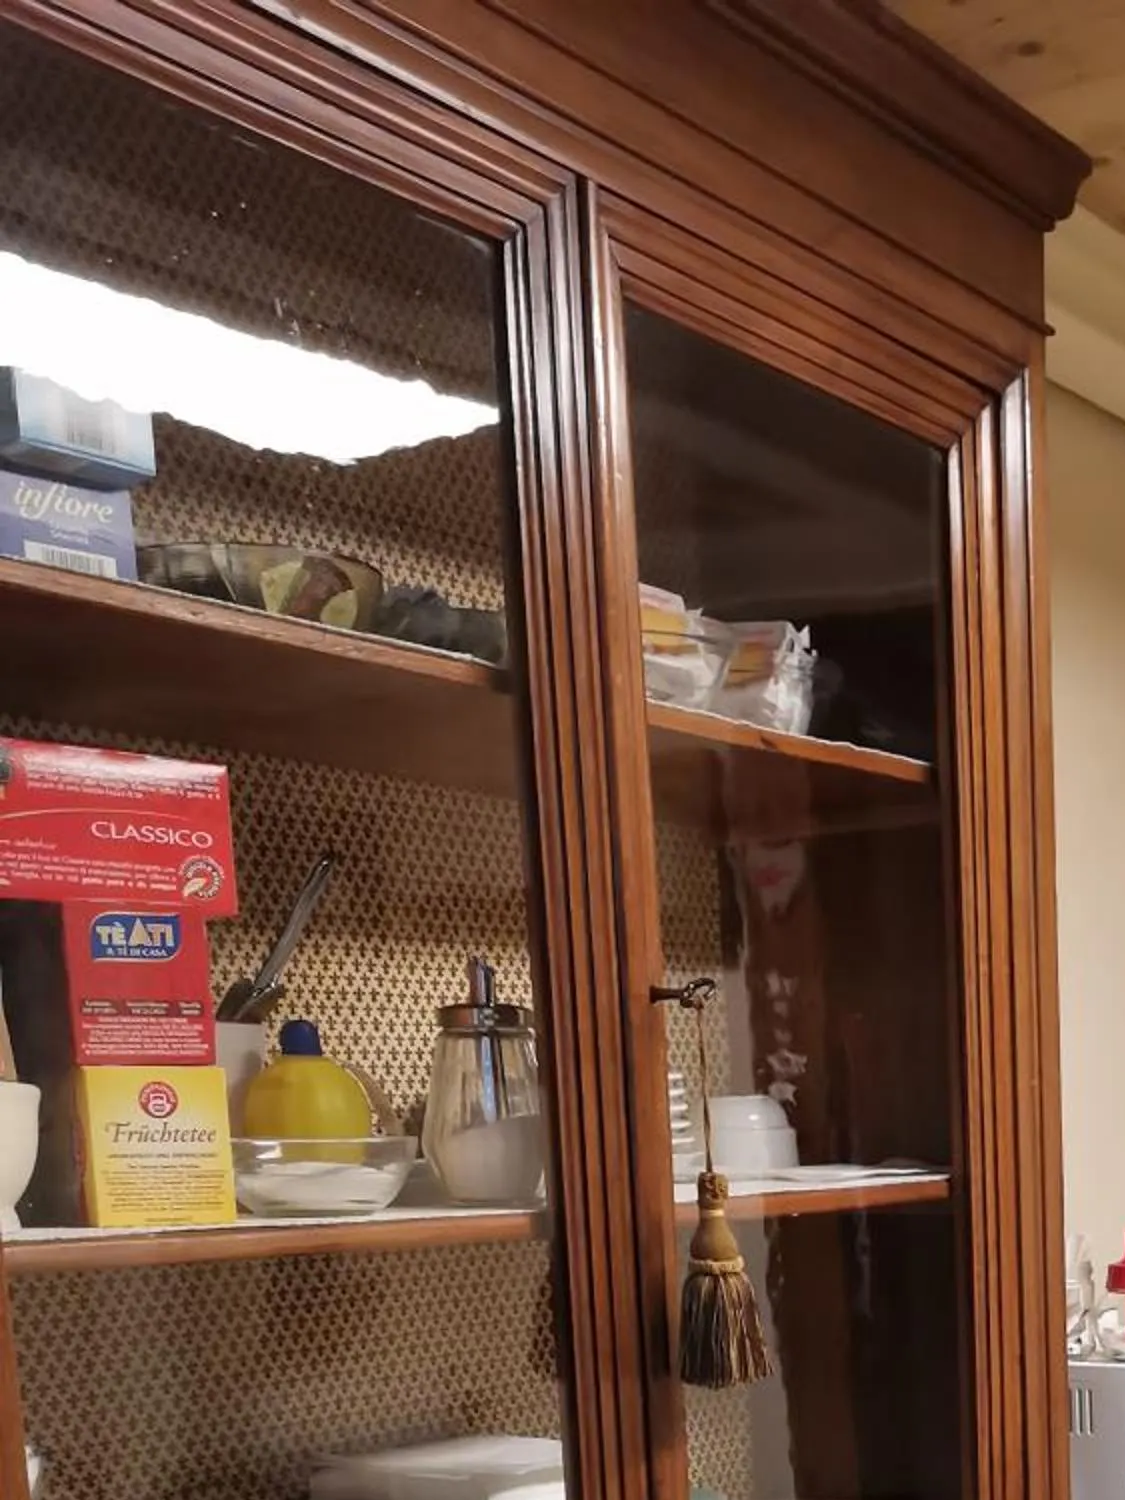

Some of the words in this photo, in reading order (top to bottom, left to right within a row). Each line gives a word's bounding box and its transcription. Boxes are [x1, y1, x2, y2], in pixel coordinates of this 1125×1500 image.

[14, 480, 114, 524] infiore
[91, 820, 214, 849] CLASSICO
[105, 1120, 216, 1145] Früchtetee
